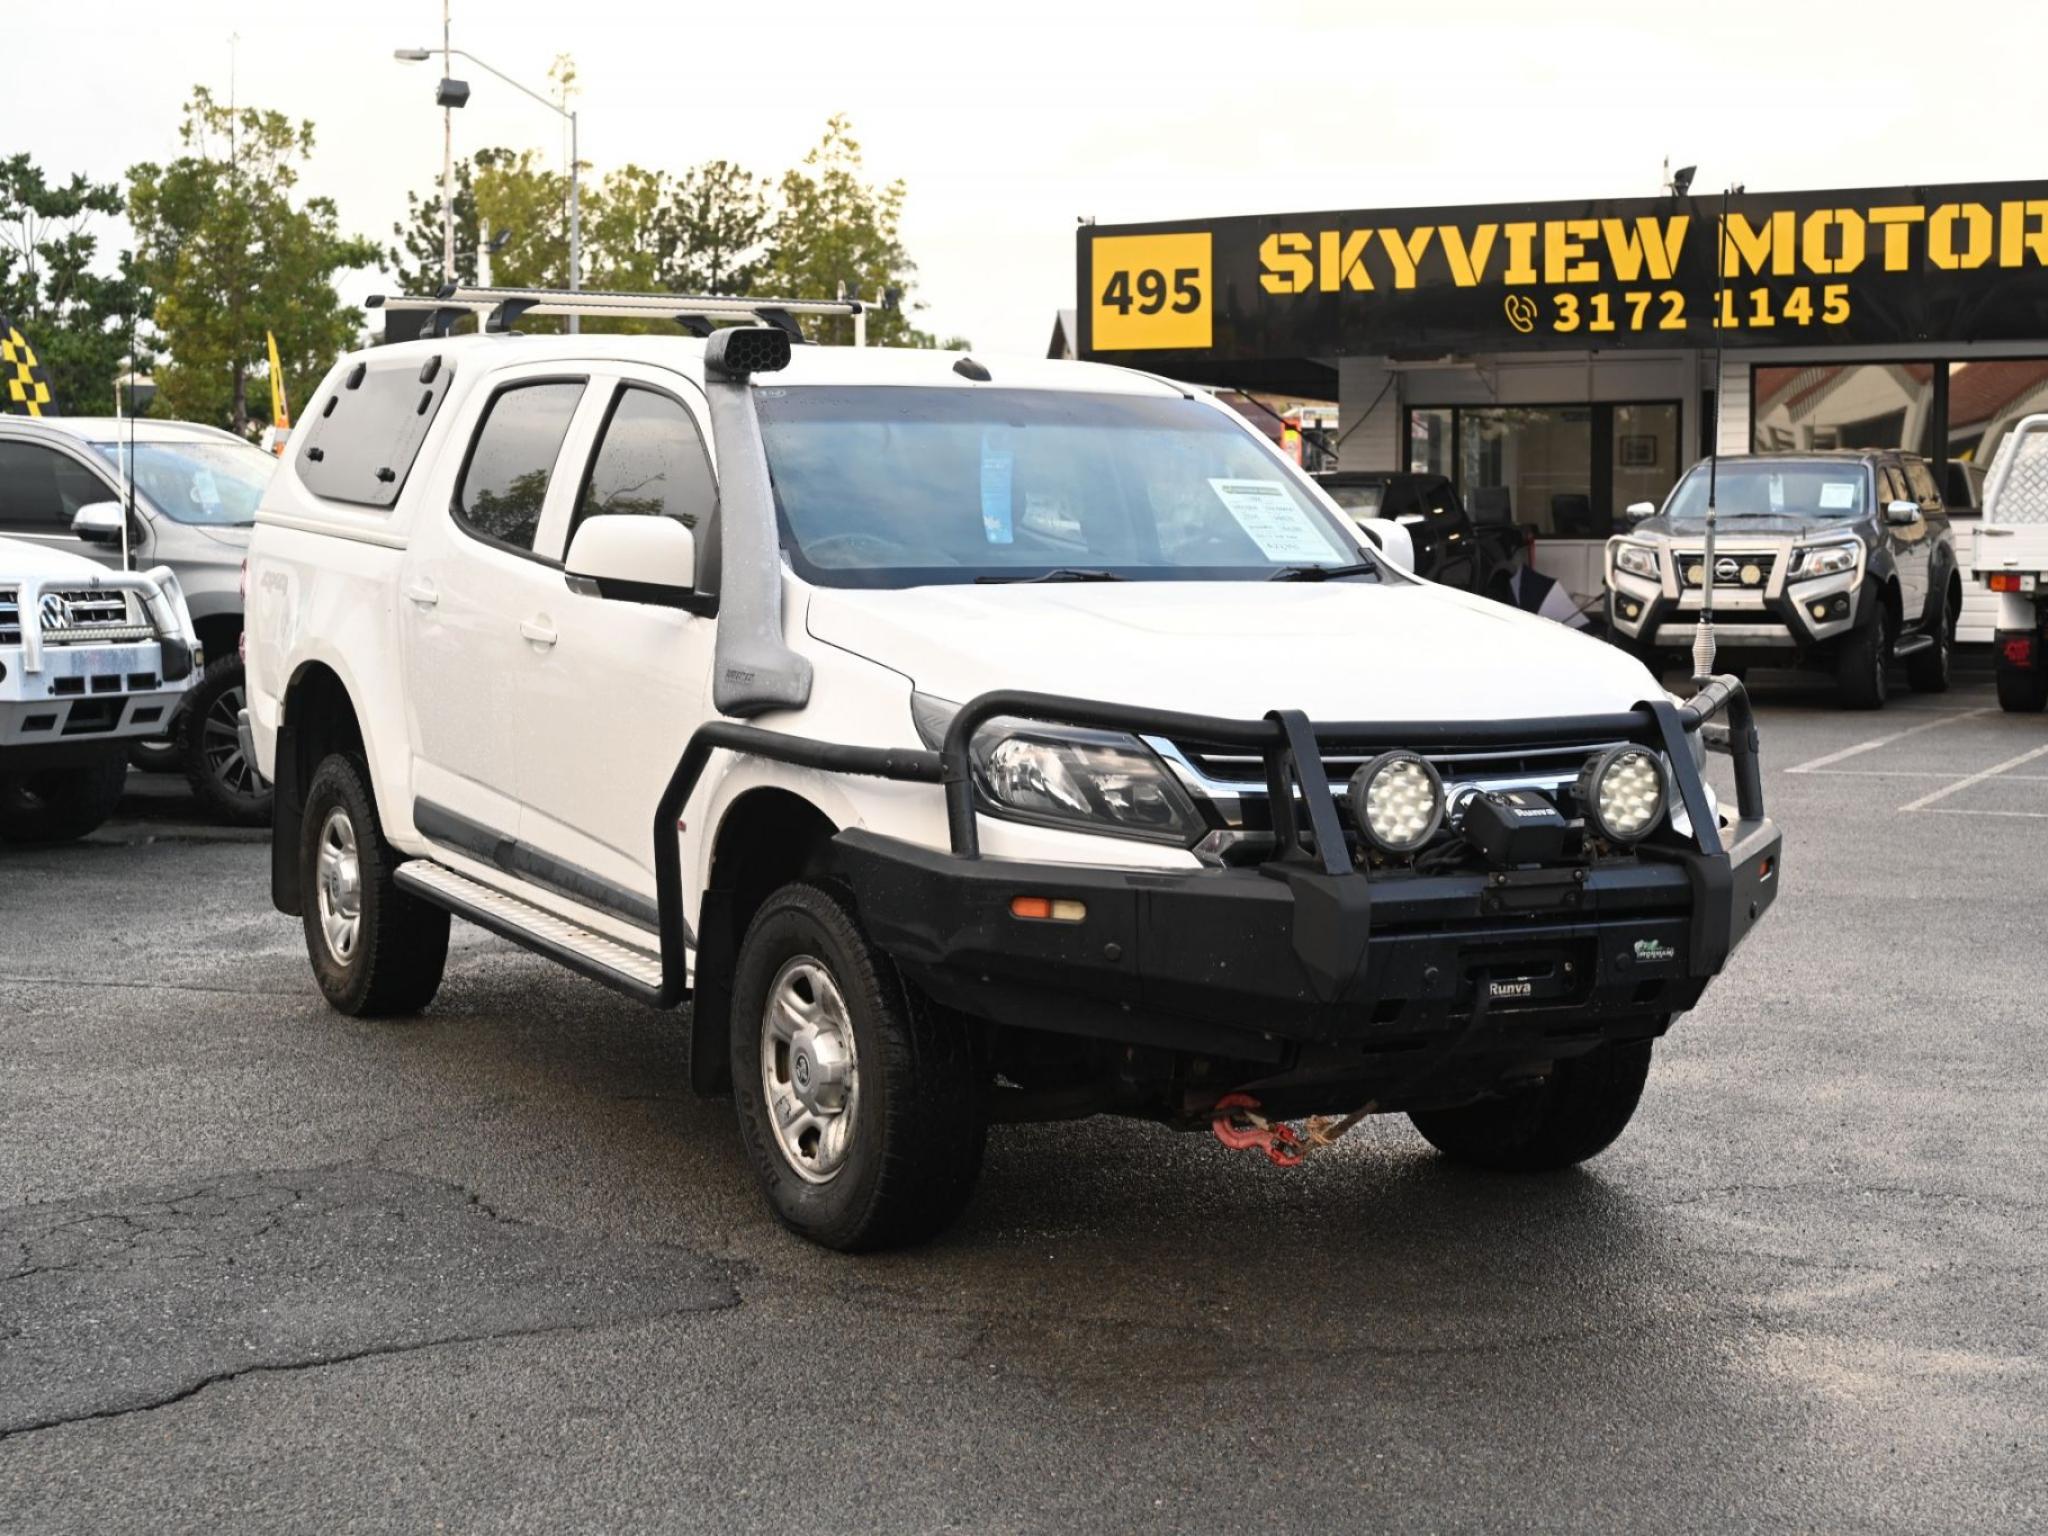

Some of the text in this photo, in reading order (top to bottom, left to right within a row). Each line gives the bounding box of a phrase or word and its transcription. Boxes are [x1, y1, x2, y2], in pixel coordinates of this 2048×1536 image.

[1259, 200, 2048, 295] SKYVIEW MOTOR
[1102, 268, 1201, 316] 495
[1553, 284, 1850, 332] 3172 1145
[1489, 982, 1531, 997] Runva
